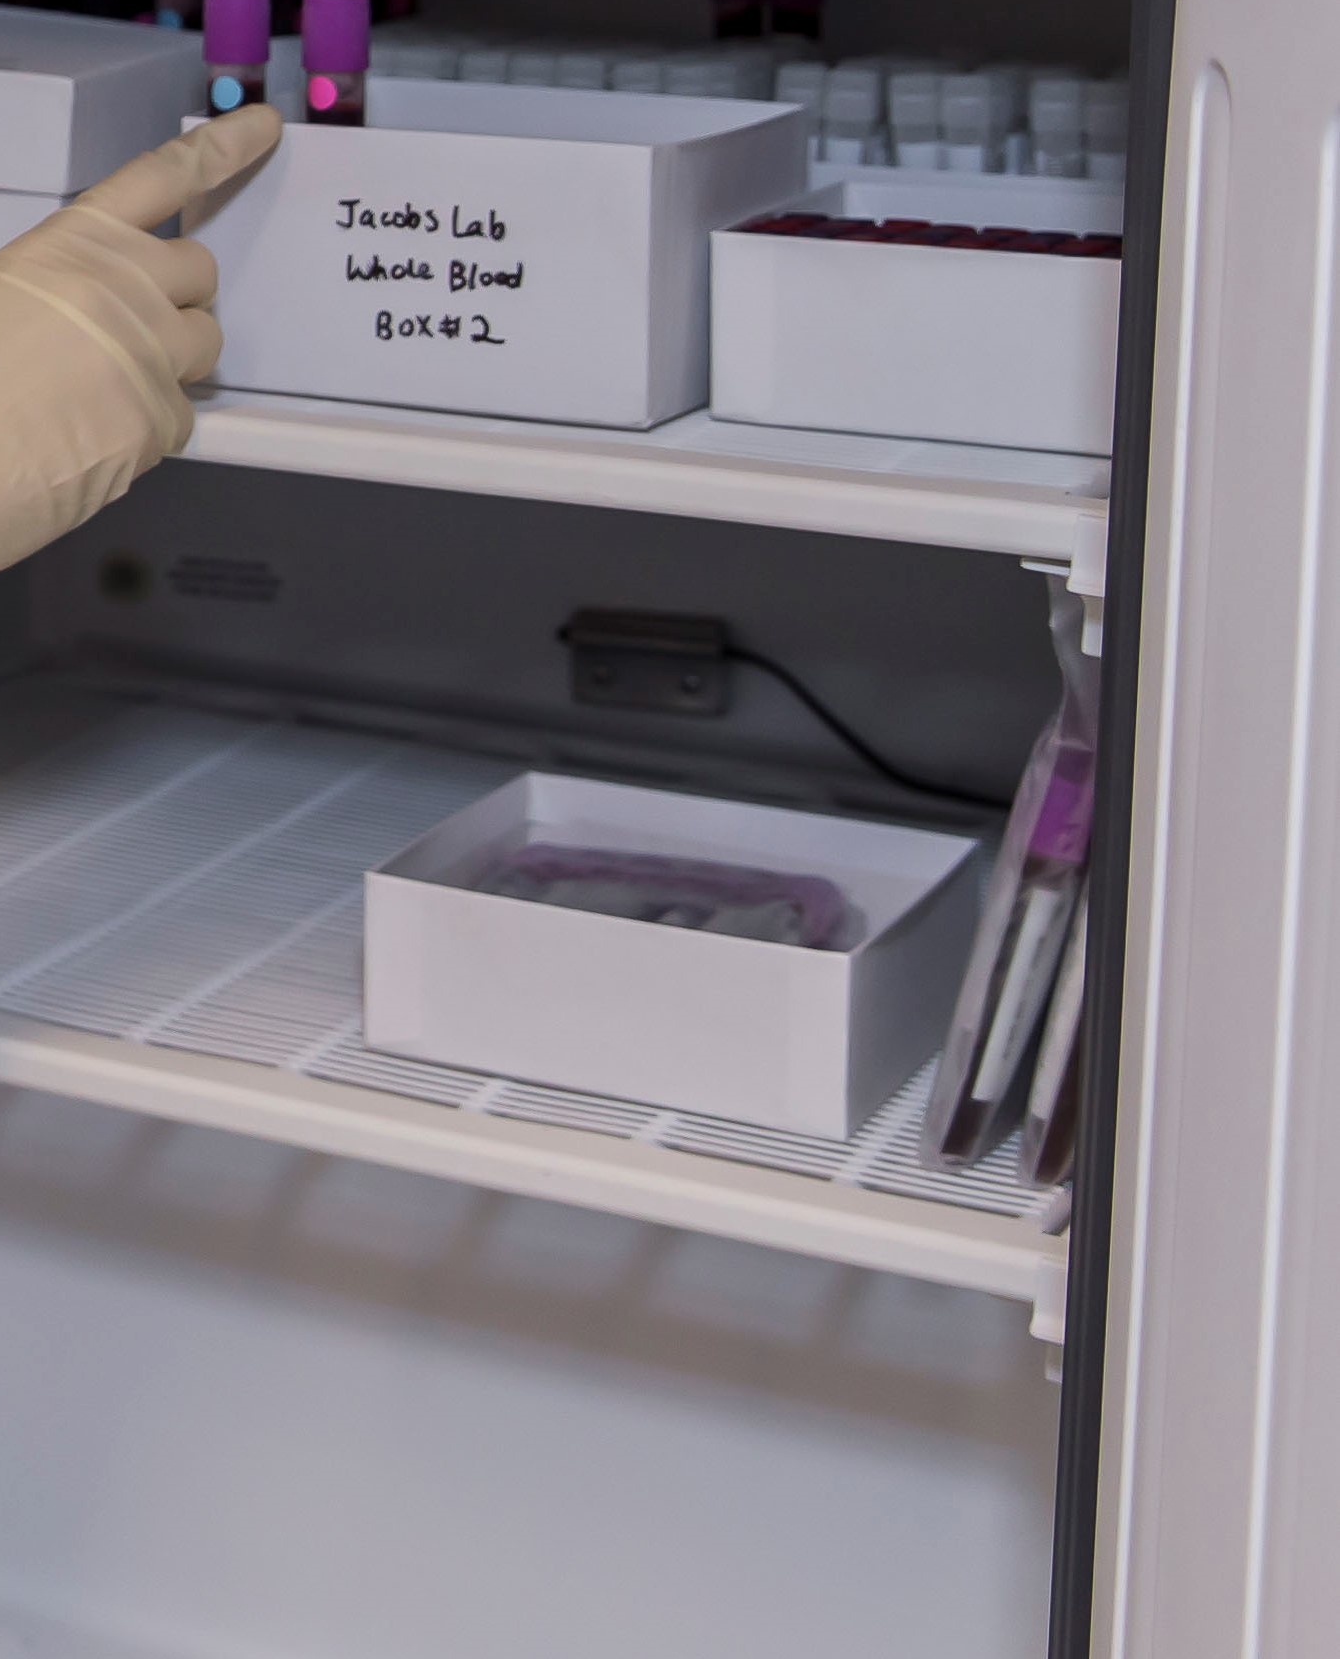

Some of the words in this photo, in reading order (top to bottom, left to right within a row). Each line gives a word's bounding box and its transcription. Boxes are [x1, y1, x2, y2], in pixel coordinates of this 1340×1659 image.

[336, 198, 439, 232] Jacobs
[451, 205, 506, 241] Lab
[346, 254, 434, 282] Whole
[449, 259, 524, 293] Blood
